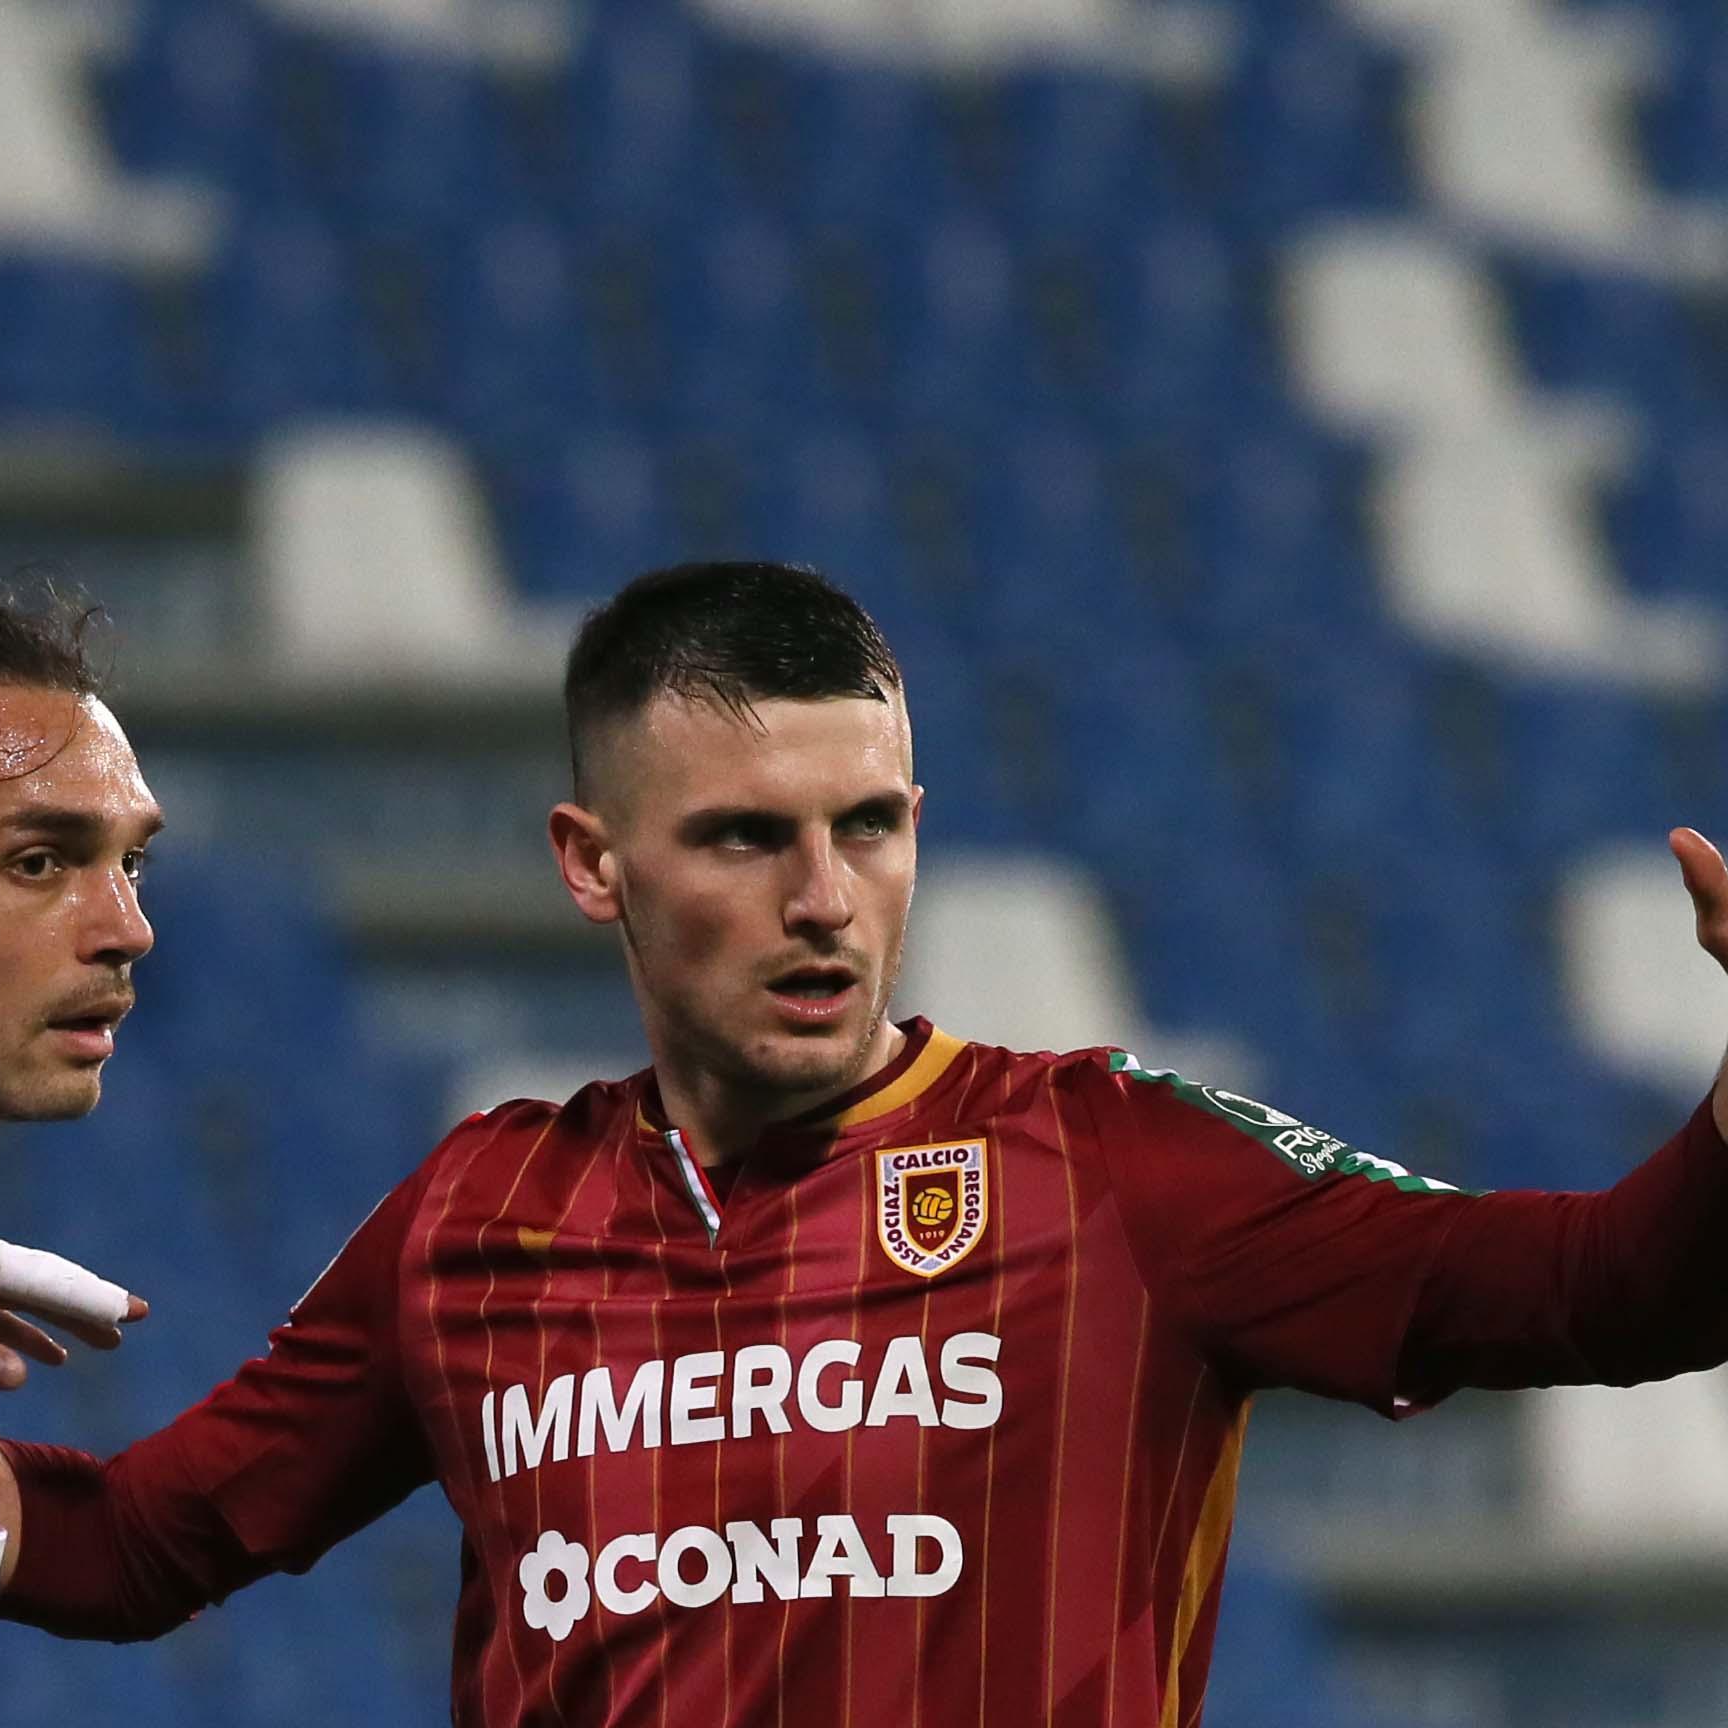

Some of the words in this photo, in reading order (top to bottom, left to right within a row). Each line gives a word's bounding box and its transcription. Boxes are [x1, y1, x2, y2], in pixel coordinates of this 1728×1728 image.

[892, 1148, 969, 1171] CALCIO
[884, 1176, 926, 1266] ASSOCIAZ.
[936, 1170, 980, 1261] REGGIANA
[481, 1331, 1004, 1482] IMMERGAS
[593, 1513, 964, 1616] CONAD
